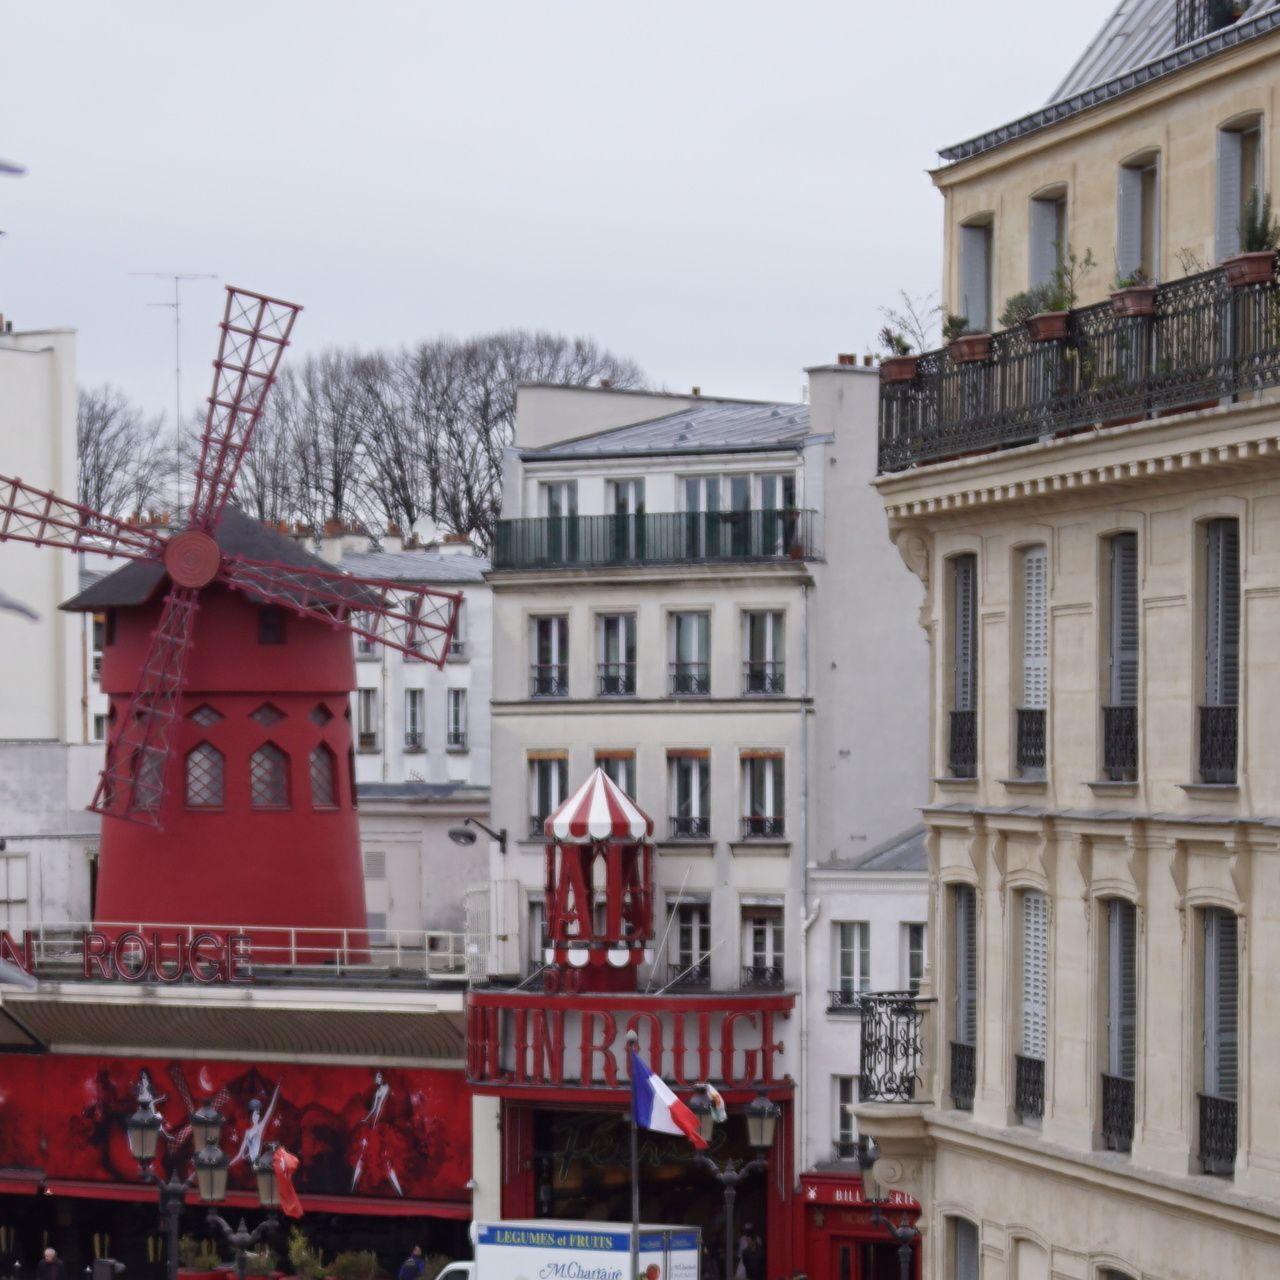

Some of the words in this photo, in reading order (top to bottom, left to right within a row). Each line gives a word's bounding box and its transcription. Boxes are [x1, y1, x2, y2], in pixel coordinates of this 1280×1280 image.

[84, 929, 256, 984] ROUGE
[582, 1010, 790, 1088] ROUGE
[569, 1234, 613, 1249] FRUITS
